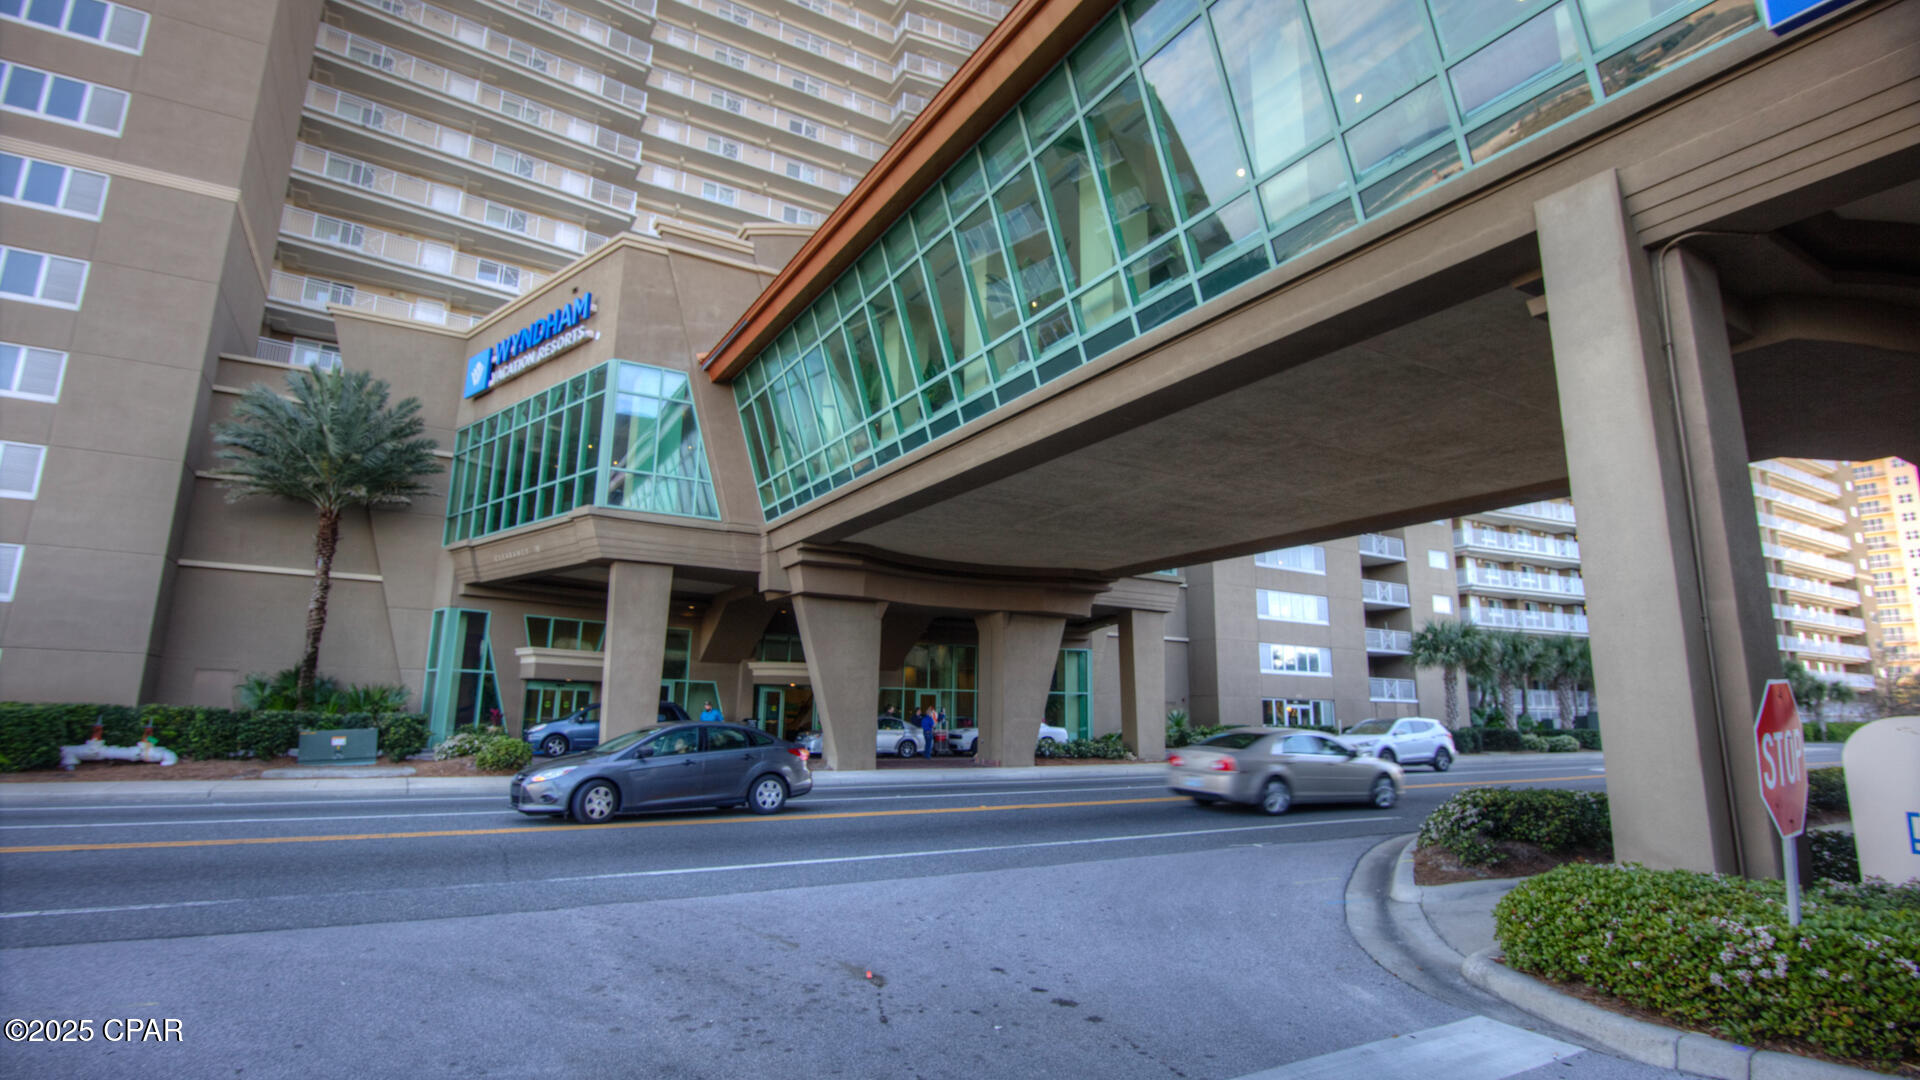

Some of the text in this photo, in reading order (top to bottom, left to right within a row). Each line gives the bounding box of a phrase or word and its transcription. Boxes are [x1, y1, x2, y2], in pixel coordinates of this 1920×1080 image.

[496, 292, 591, 365] WYNDHAM
[537, 326, 587, 361] RESORTS
[1762, 729, 1802, 790] STOP
